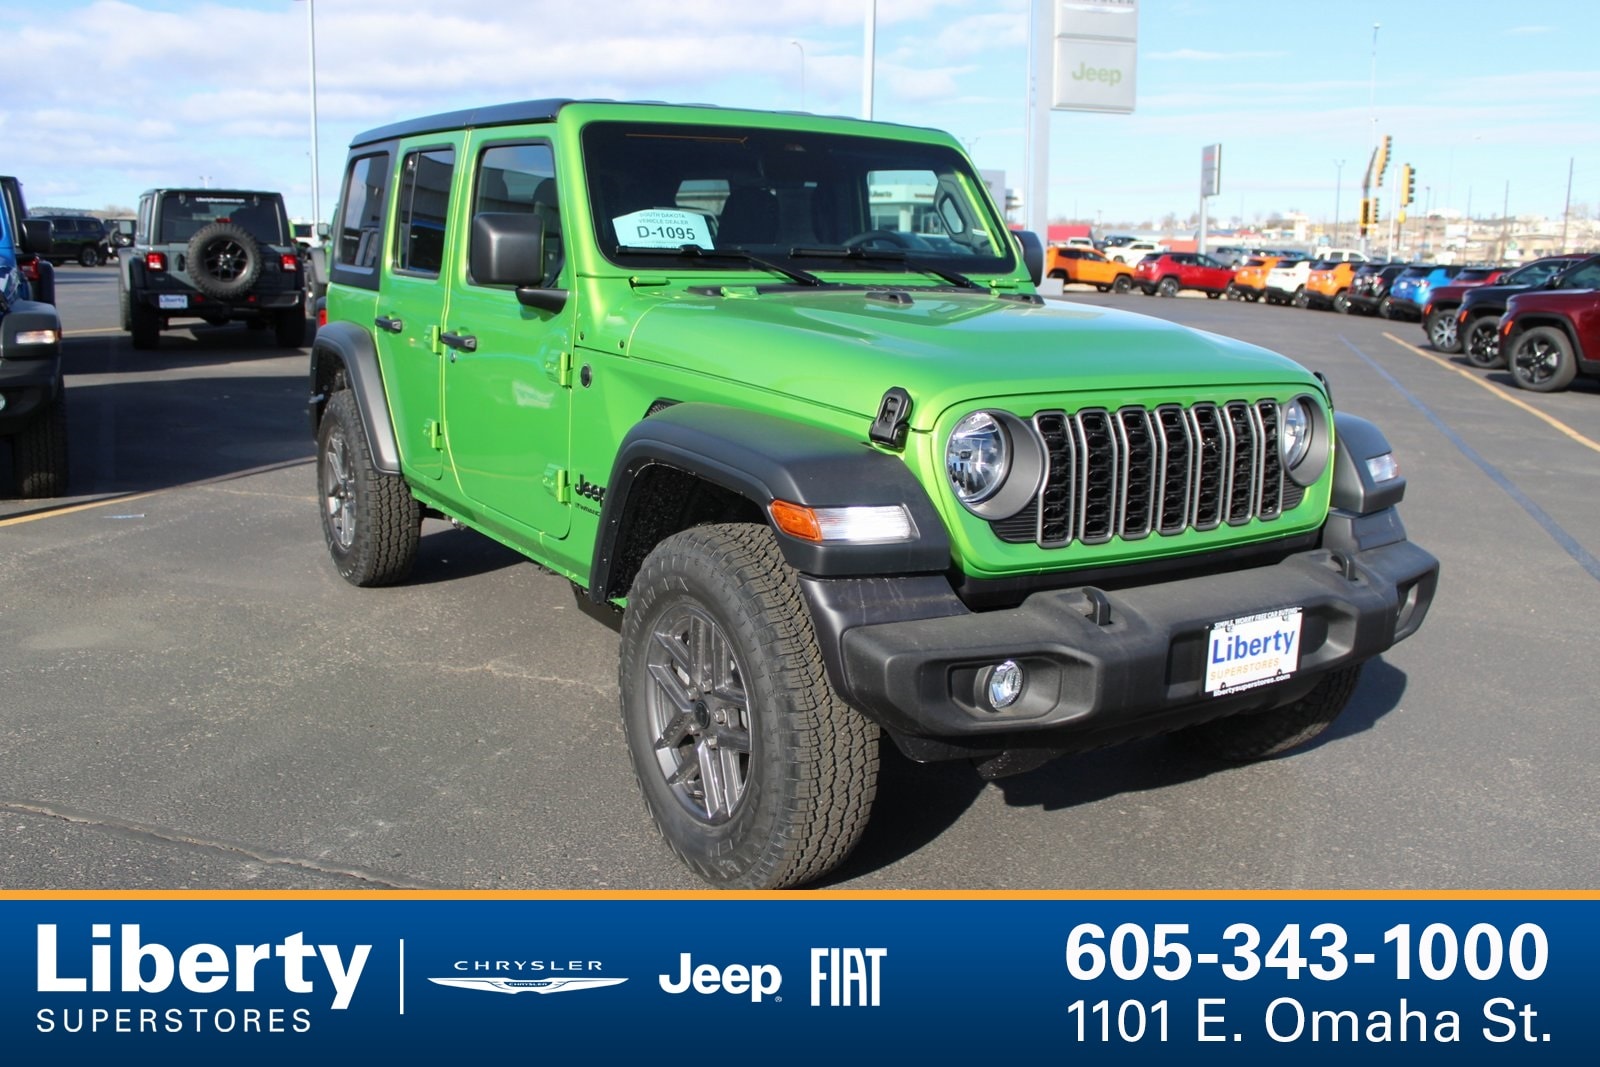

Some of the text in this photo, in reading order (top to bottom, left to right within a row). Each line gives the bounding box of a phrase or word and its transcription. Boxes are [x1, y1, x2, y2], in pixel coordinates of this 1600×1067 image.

[1071, 62, 1123, 87] Jeep
[637, 225, 696, 241] D-1095
[1212, 630, 1295, 664] Liberty
[1210, 657, 1280, 681] SUPERSTORES
